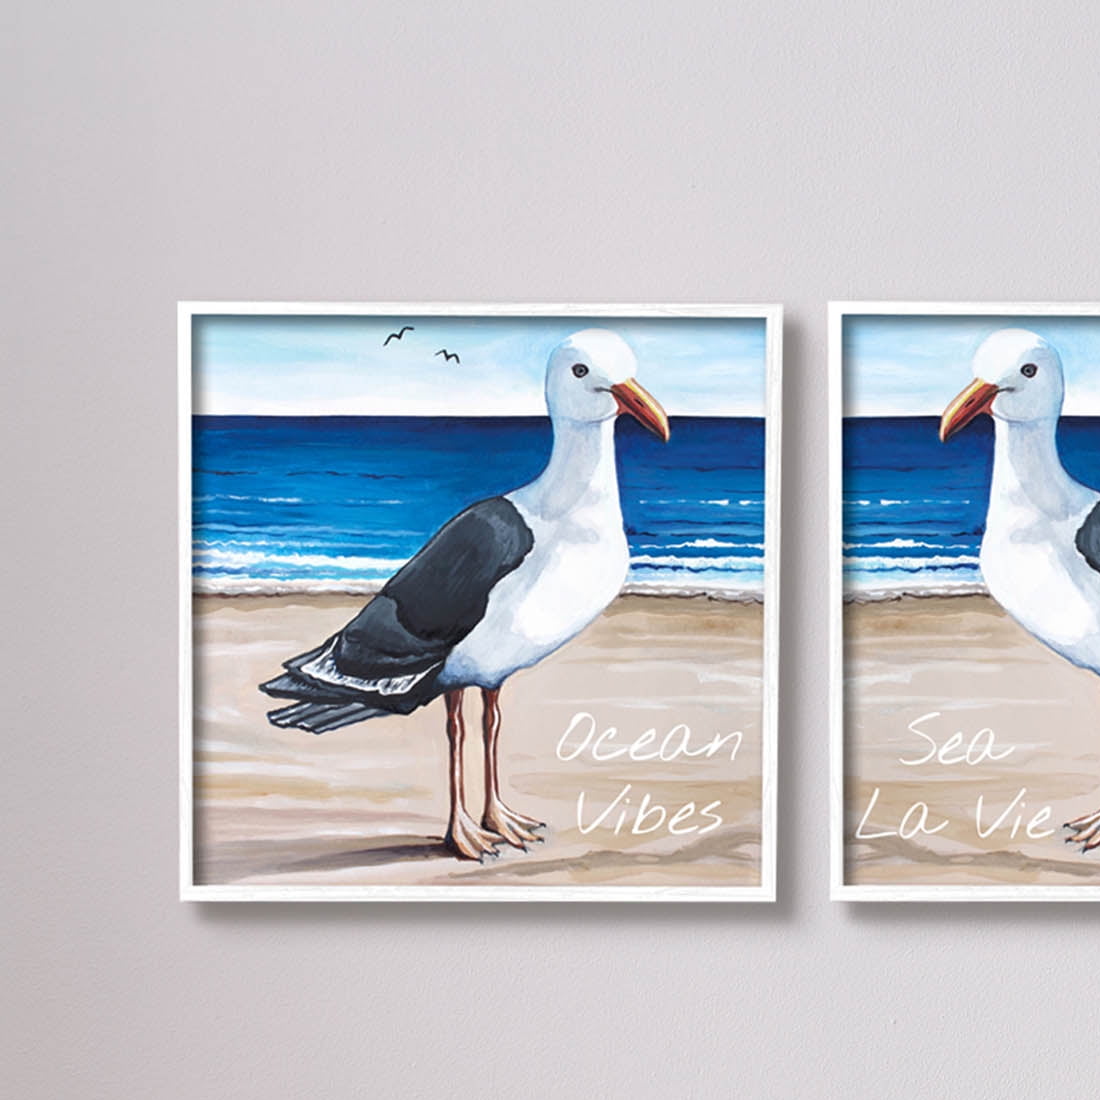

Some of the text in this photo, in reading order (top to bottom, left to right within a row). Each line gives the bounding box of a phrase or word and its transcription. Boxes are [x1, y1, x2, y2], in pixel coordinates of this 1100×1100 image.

[556, 711, 744, 761] Ocean
[899, 711, 1016, 765] Sea
[577, 784, 722, 835] Vibes
[856, 788, 1055, 839] La Vie
